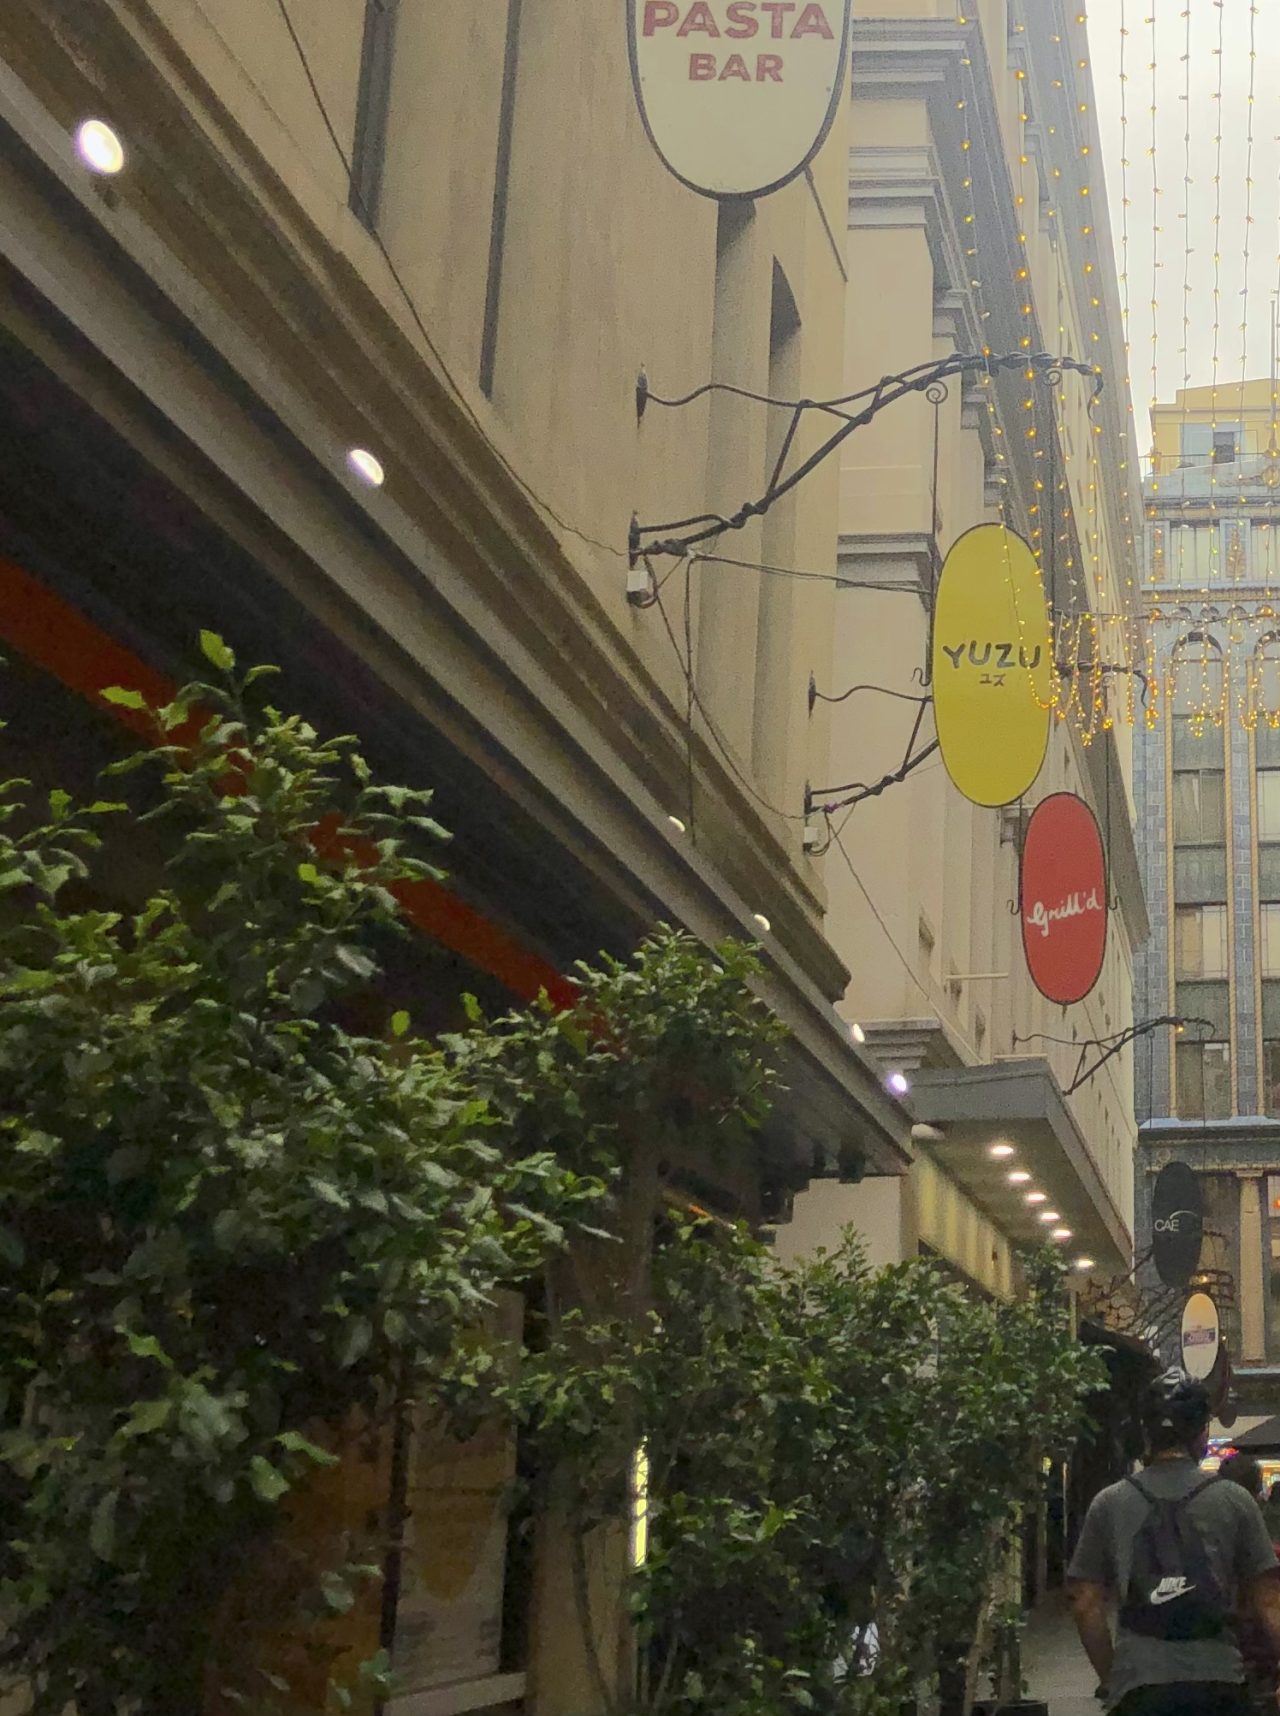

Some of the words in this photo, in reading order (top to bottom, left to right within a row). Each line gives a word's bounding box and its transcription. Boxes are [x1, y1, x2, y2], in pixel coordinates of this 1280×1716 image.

[642, 1, 834, 39] PASTA
[688, 53, 783, 82] BAR
[942, 640, 1040, 669] YUZU
[1026, 888, 1103, 937] Grill'd
[1154, 1219, 1180, 1232] CAE
[1157, 1576, 1186, 1592] NIKE
